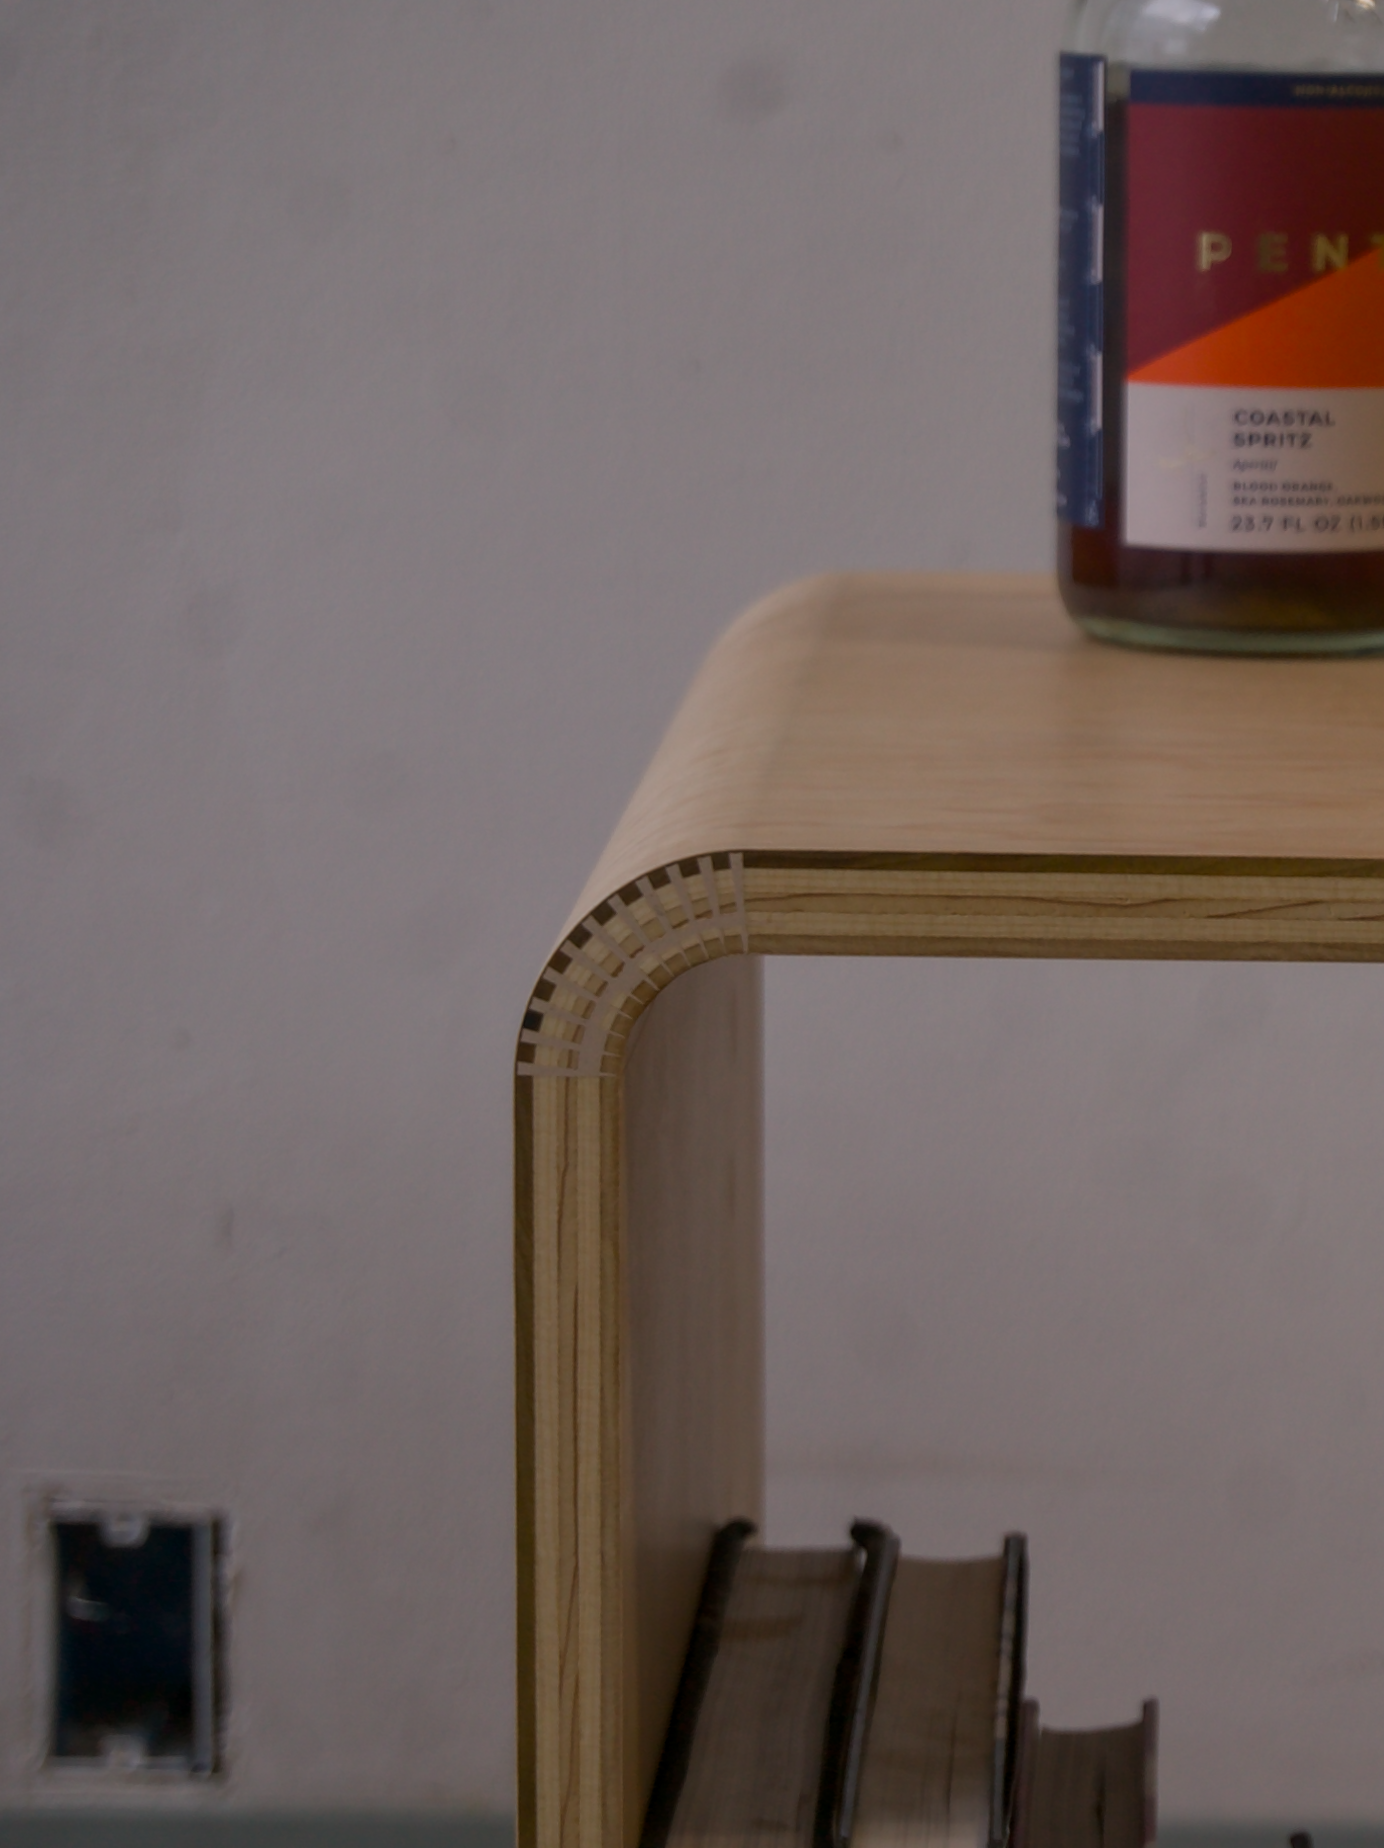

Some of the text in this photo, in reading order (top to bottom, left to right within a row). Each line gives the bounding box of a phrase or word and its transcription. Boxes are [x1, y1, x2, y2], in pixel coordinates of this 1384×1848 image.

[1232, 408, 1336, 427] COASTAL
[1232, 431, 1313, 449] SPRITZ
[1233, 481, 1278, 493] BLOOD
[1232, 495, 1257, 507] SEA
[1231, 514, 1274, 533] 23.7
[1282, 514, 1305, 533] FL
[1314, 515, 1342, 533] OZ
